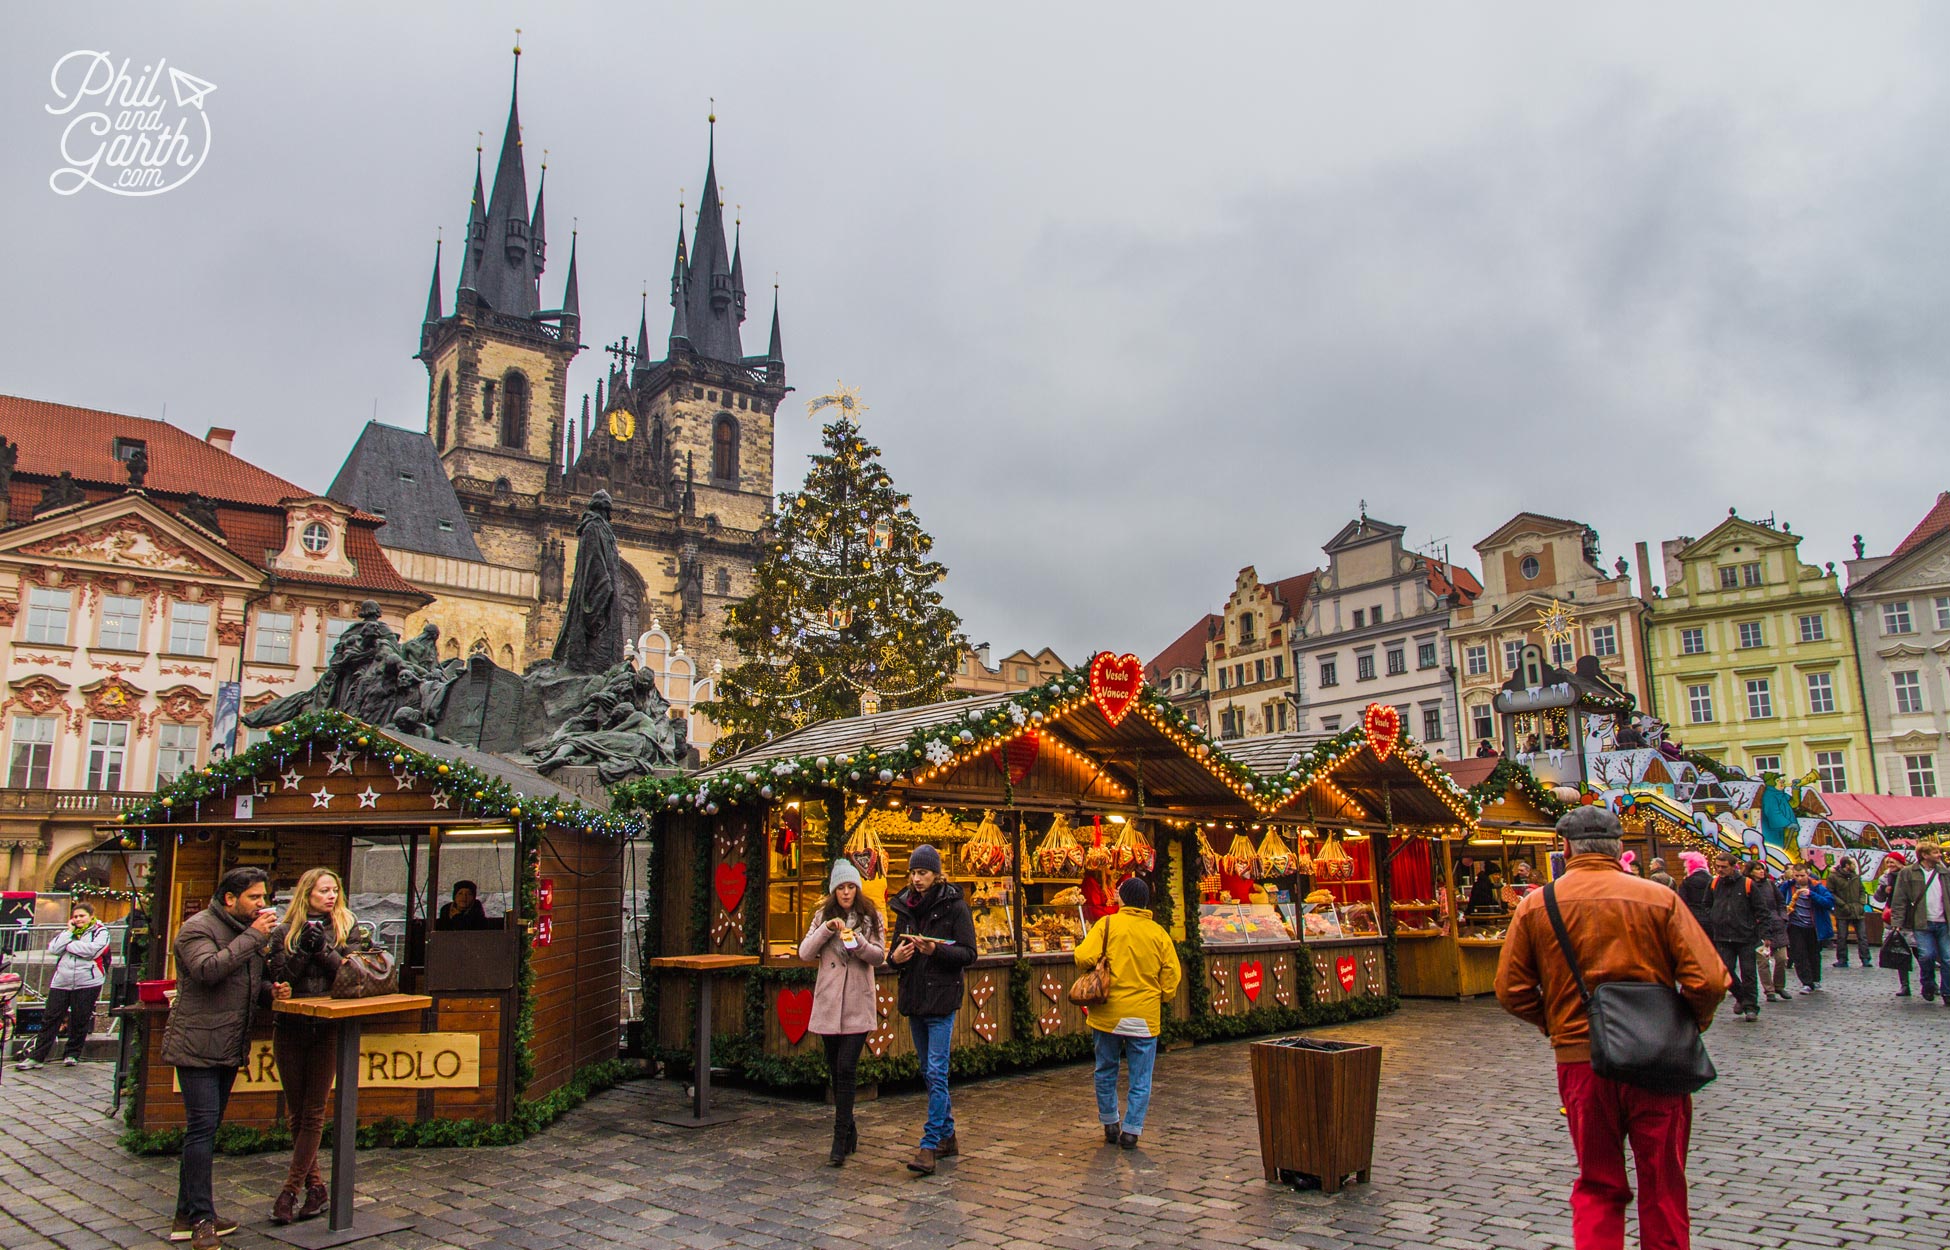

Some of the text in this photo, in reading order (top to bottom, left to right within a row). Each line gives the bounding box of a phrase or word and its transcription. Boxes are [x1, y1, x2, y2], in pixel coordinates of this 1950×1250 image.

[1101, 686, 1129, 699] Vánoce
[240, 799, 249, 809] 4
[358, 1048, 462, 1082] RDLO
